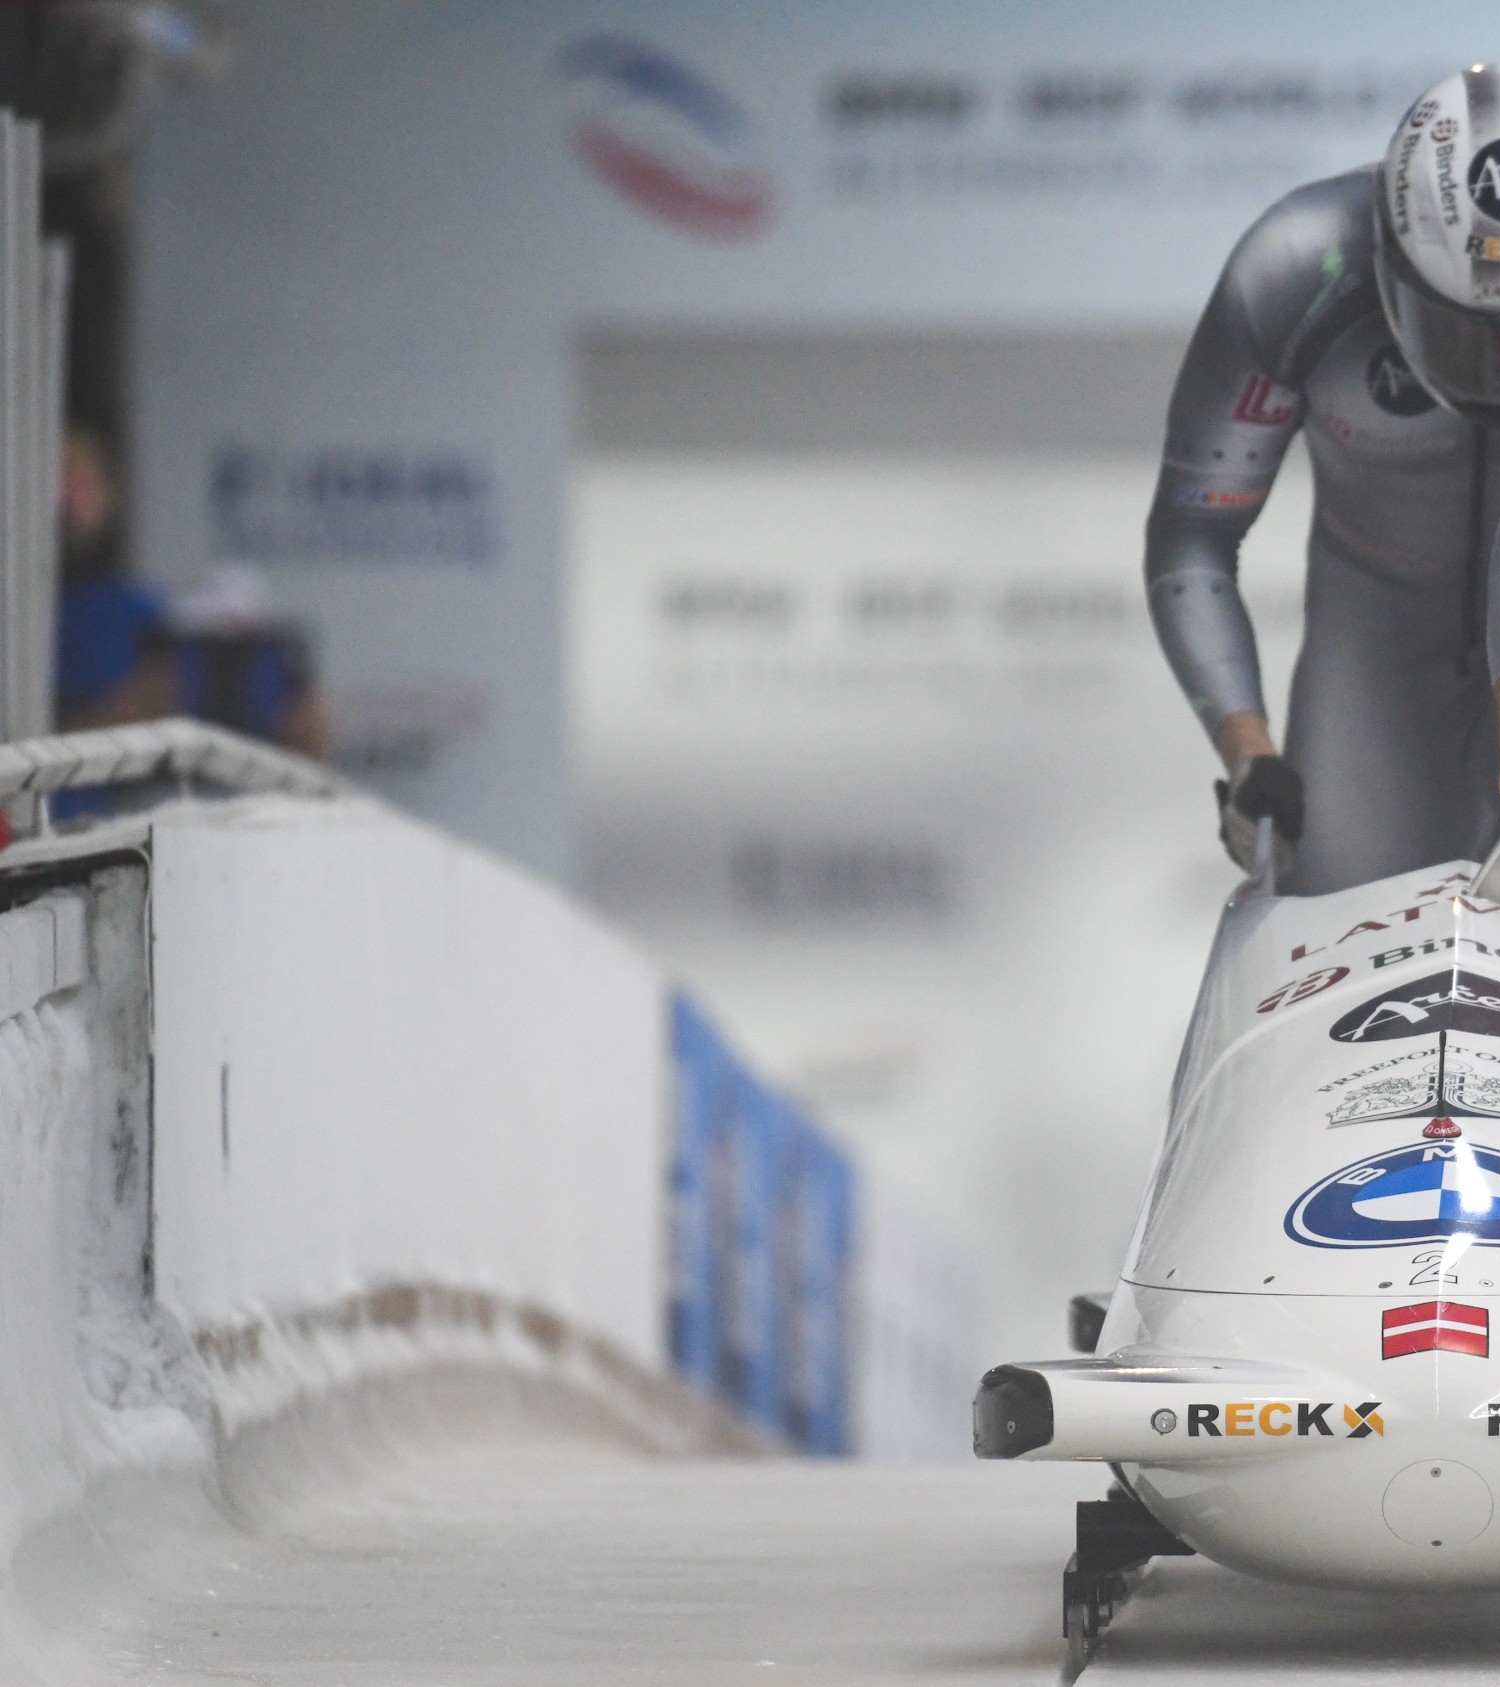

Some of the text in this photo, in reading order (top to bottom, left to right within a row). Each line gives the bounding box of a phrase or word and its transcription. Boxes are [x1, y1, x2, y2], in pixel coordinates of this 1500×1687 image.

[1314, 1044, 1470, 1094] FREEPORT
[1408, 1250, 1460, 1287] 2
[1187, 1402, 1335, 1438] RECK
